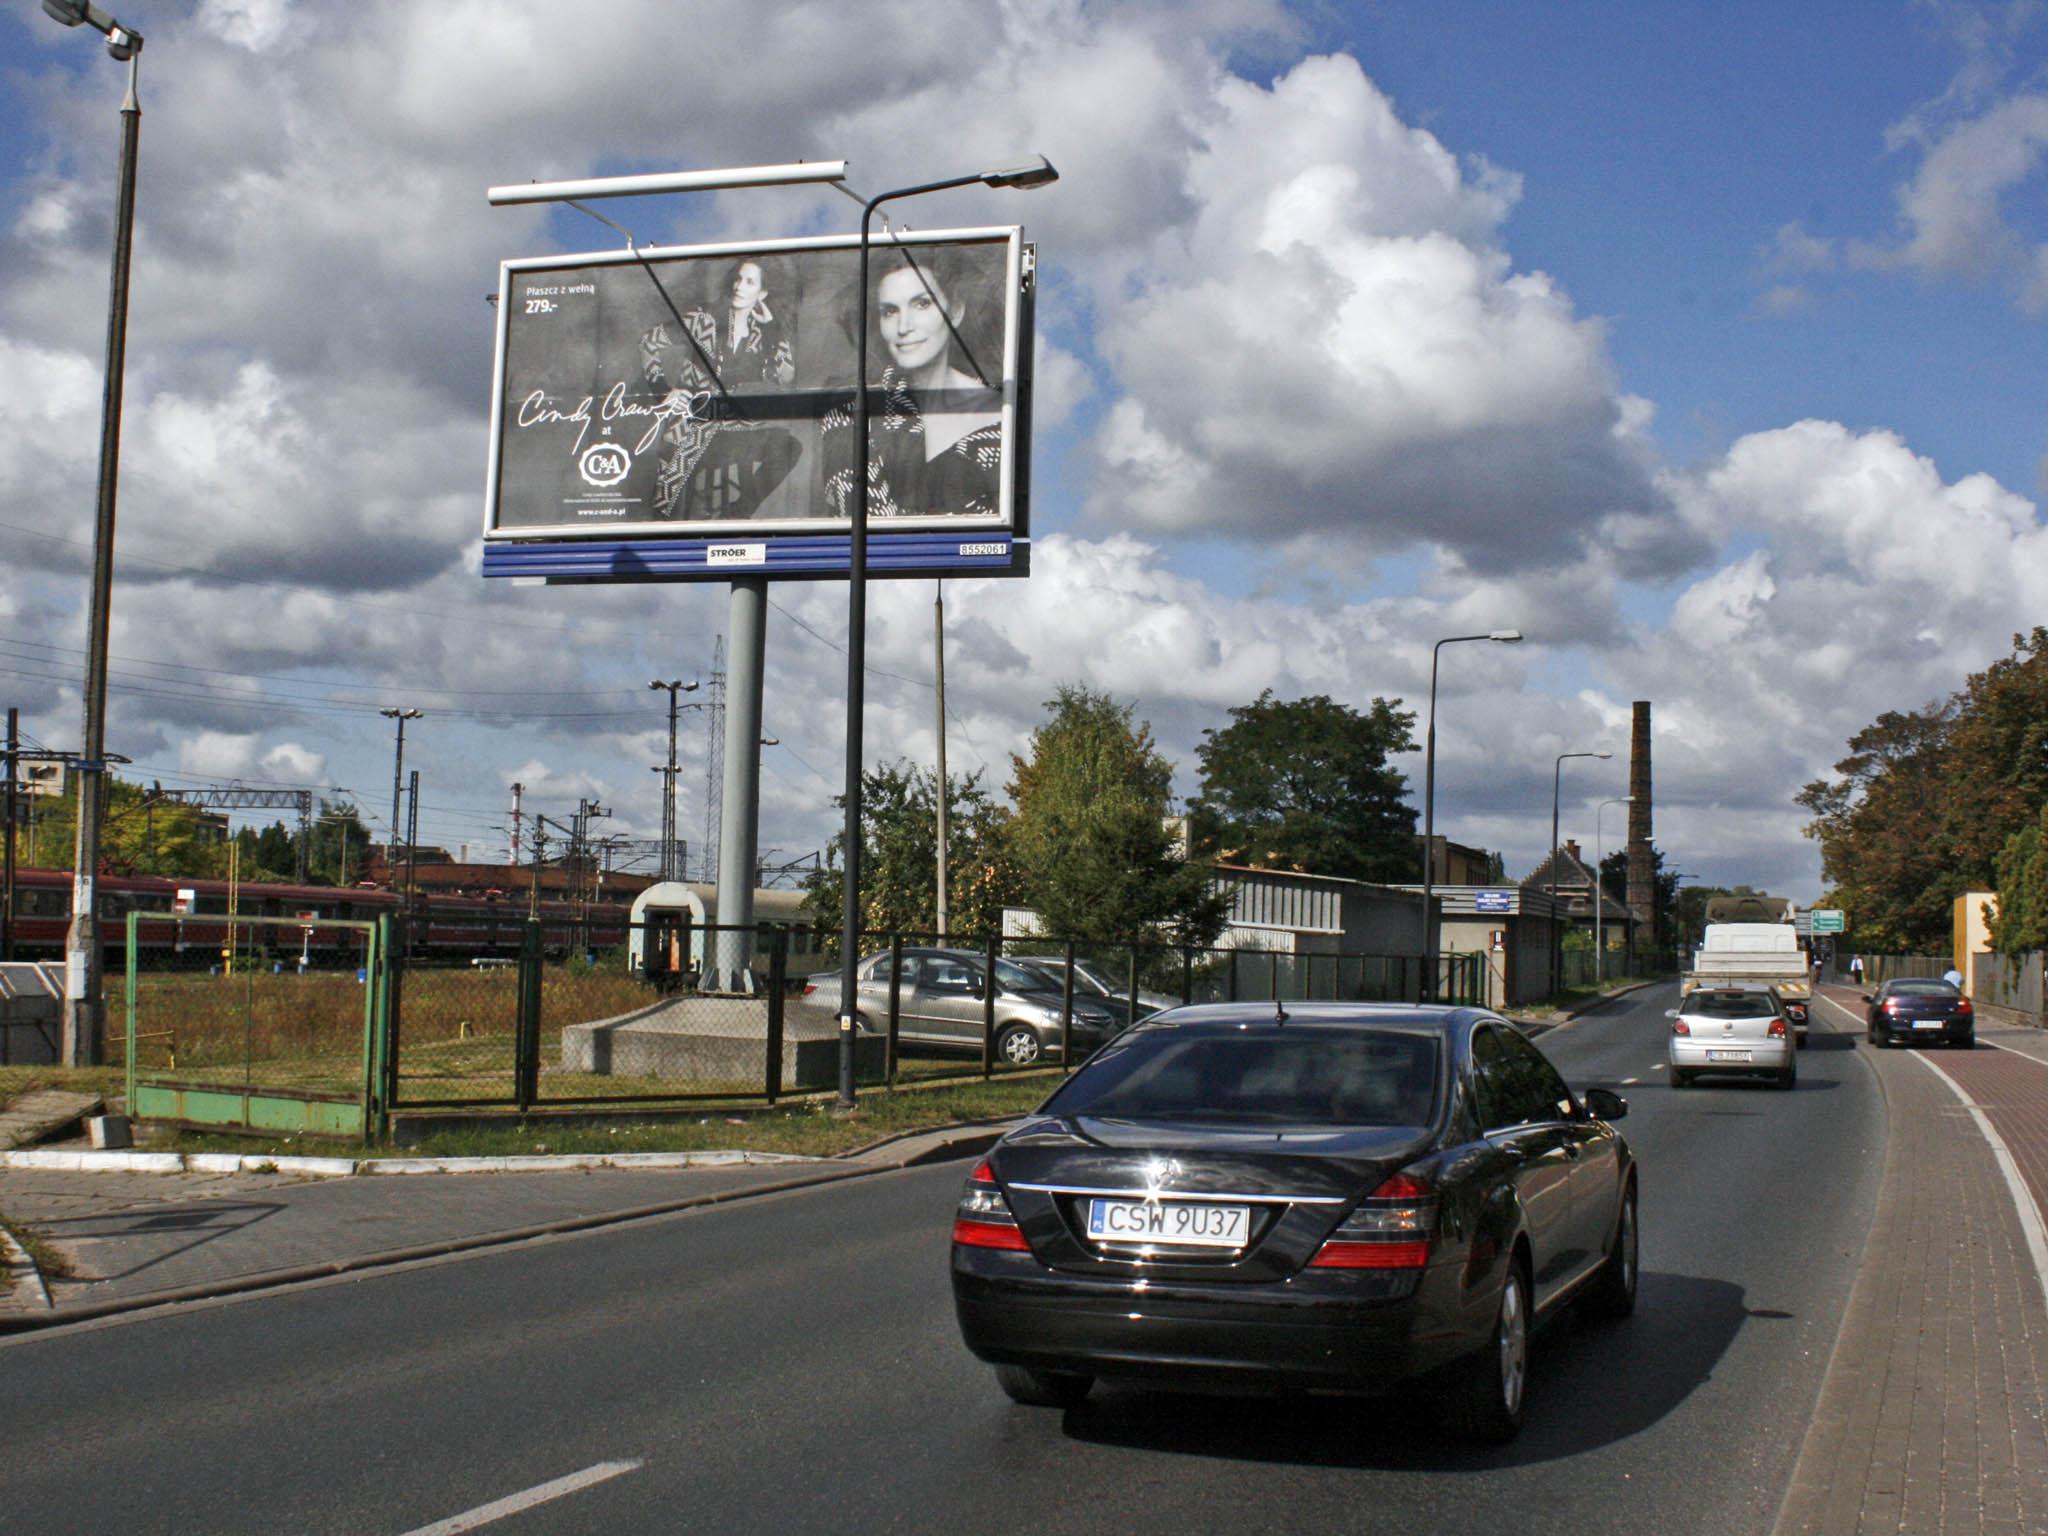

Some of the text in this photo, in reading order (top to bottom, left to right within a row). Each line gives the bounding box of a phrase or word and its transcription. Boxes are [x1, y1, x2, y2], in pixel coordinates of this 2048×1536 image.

[560, 285, 566, 295] z
[525, 299, 558, 314] 279.-
[517, 389, 594, 455] Cindy
[601, 426, 612, 436] at
[588, 454, 620, 475] C&A
[961, 545, 1004, 554] 8552061
[1109, 1205, 1241, 1236] CSW 9U37
